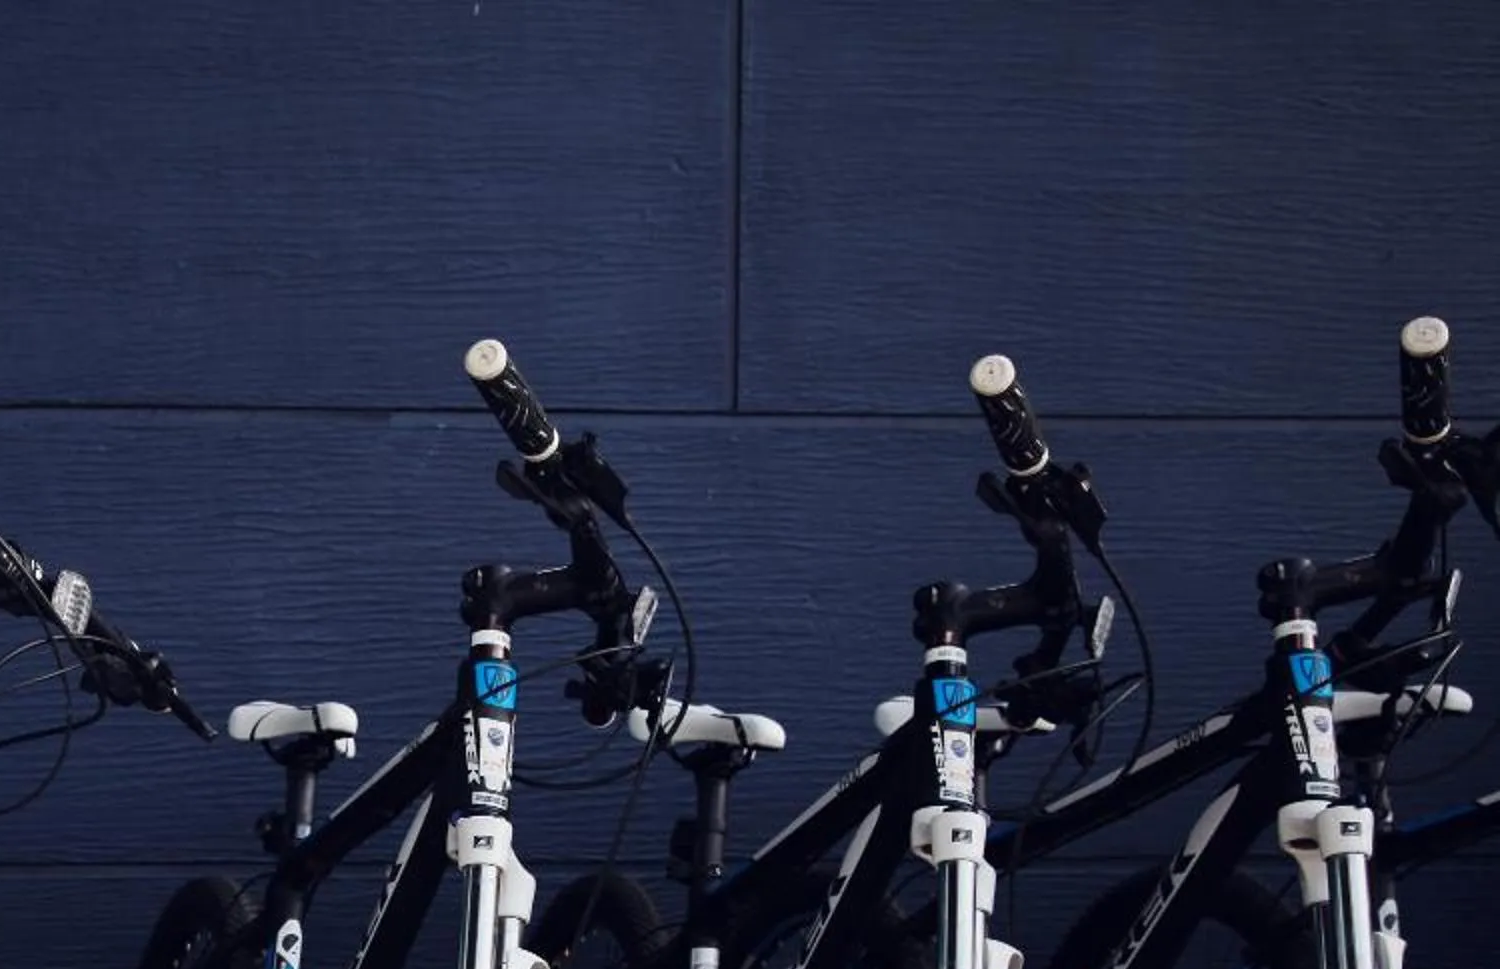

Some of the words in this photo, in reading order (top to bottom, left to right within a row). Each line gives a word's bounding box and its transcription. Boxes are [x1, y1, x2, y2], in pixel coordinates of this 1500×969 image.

[463, 709, 481, 785] TREK
[930, 720, 947, 788] TREK
[1284, 703, 1314, 774] TREK
